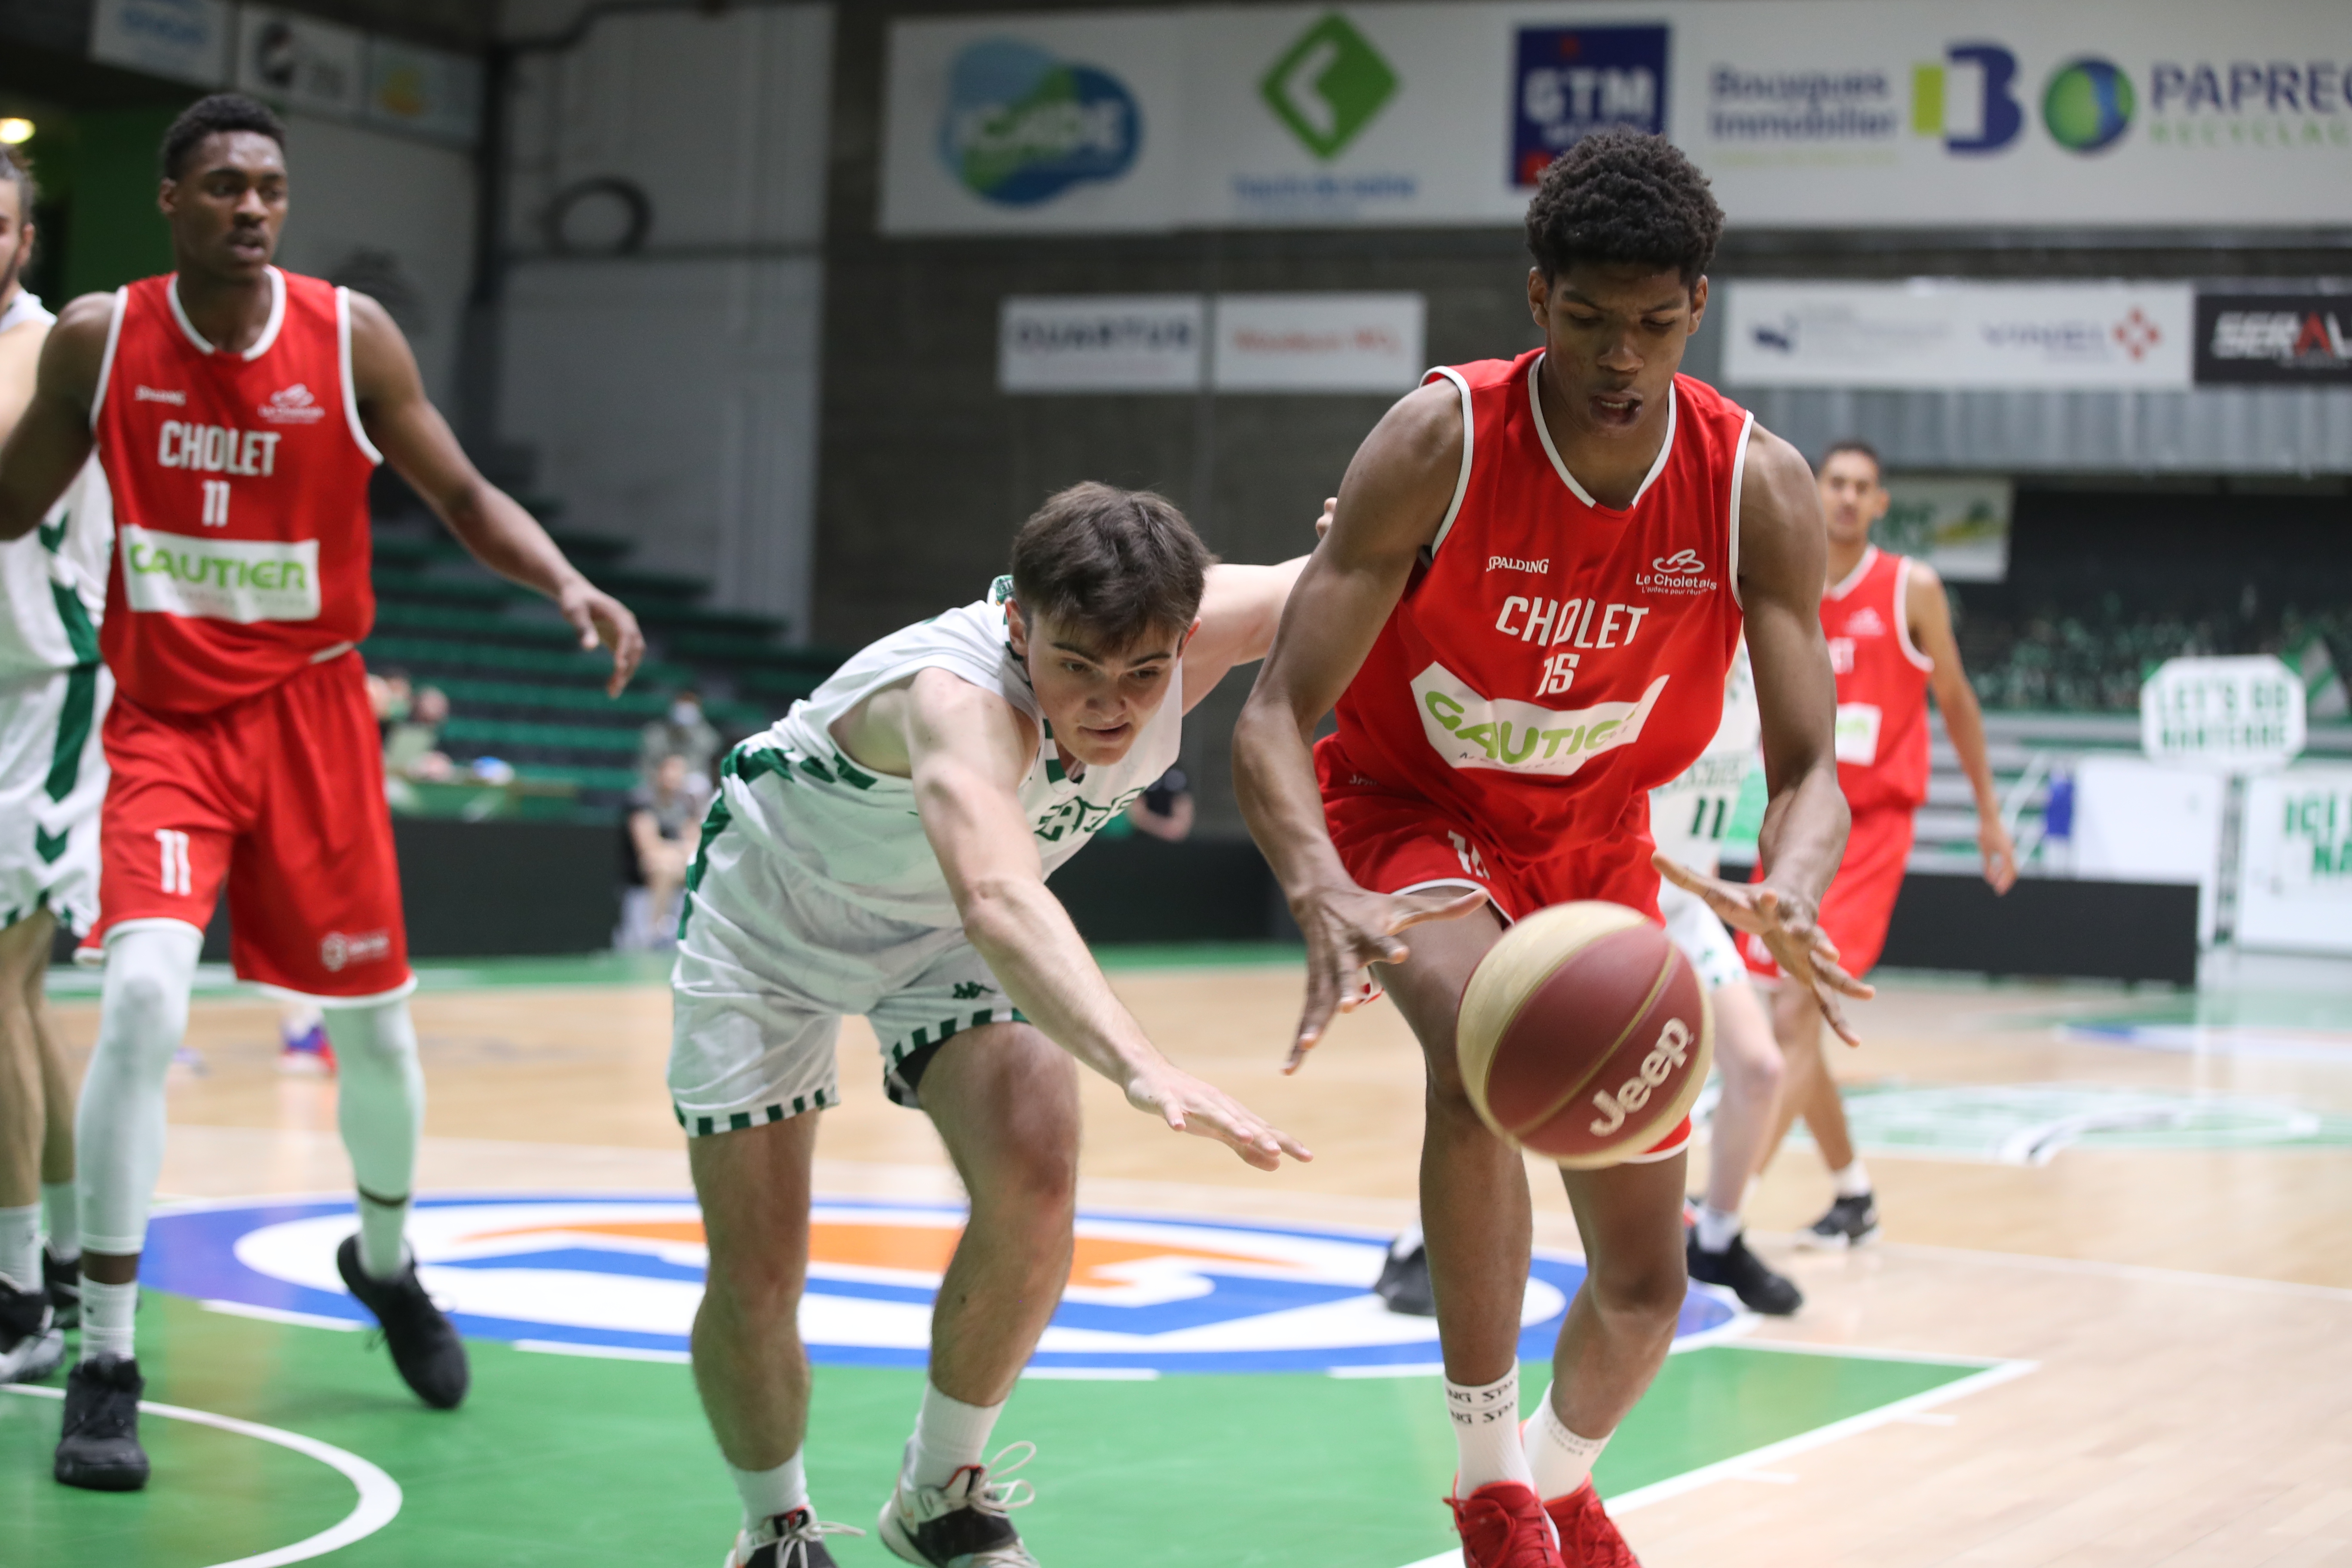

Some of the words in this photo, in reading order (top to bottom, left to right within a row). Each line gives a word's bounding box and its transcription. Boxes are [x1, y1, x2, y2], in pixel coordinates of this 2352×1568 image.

[1522, 67, 1658, 124] GTM
[2151, 62, 2352, 114] PAPRE
[158, 420, 282, 477] CHOLET
[201, 479, 231, 528] 11
[1486, 556, 1550, 574] SPALDING
[1635, 573, 1651, 585] Le
[1654, 573, 1717, 590] Choletais
[1495, 596, 1650, 649] CHOLET
[1535, 653, 1580, 697] 15
[1691, 797, 1727, 840] 11
[155, 829, 191, 896] 11
[1589, 1017, 1689, 1137] Jeep
